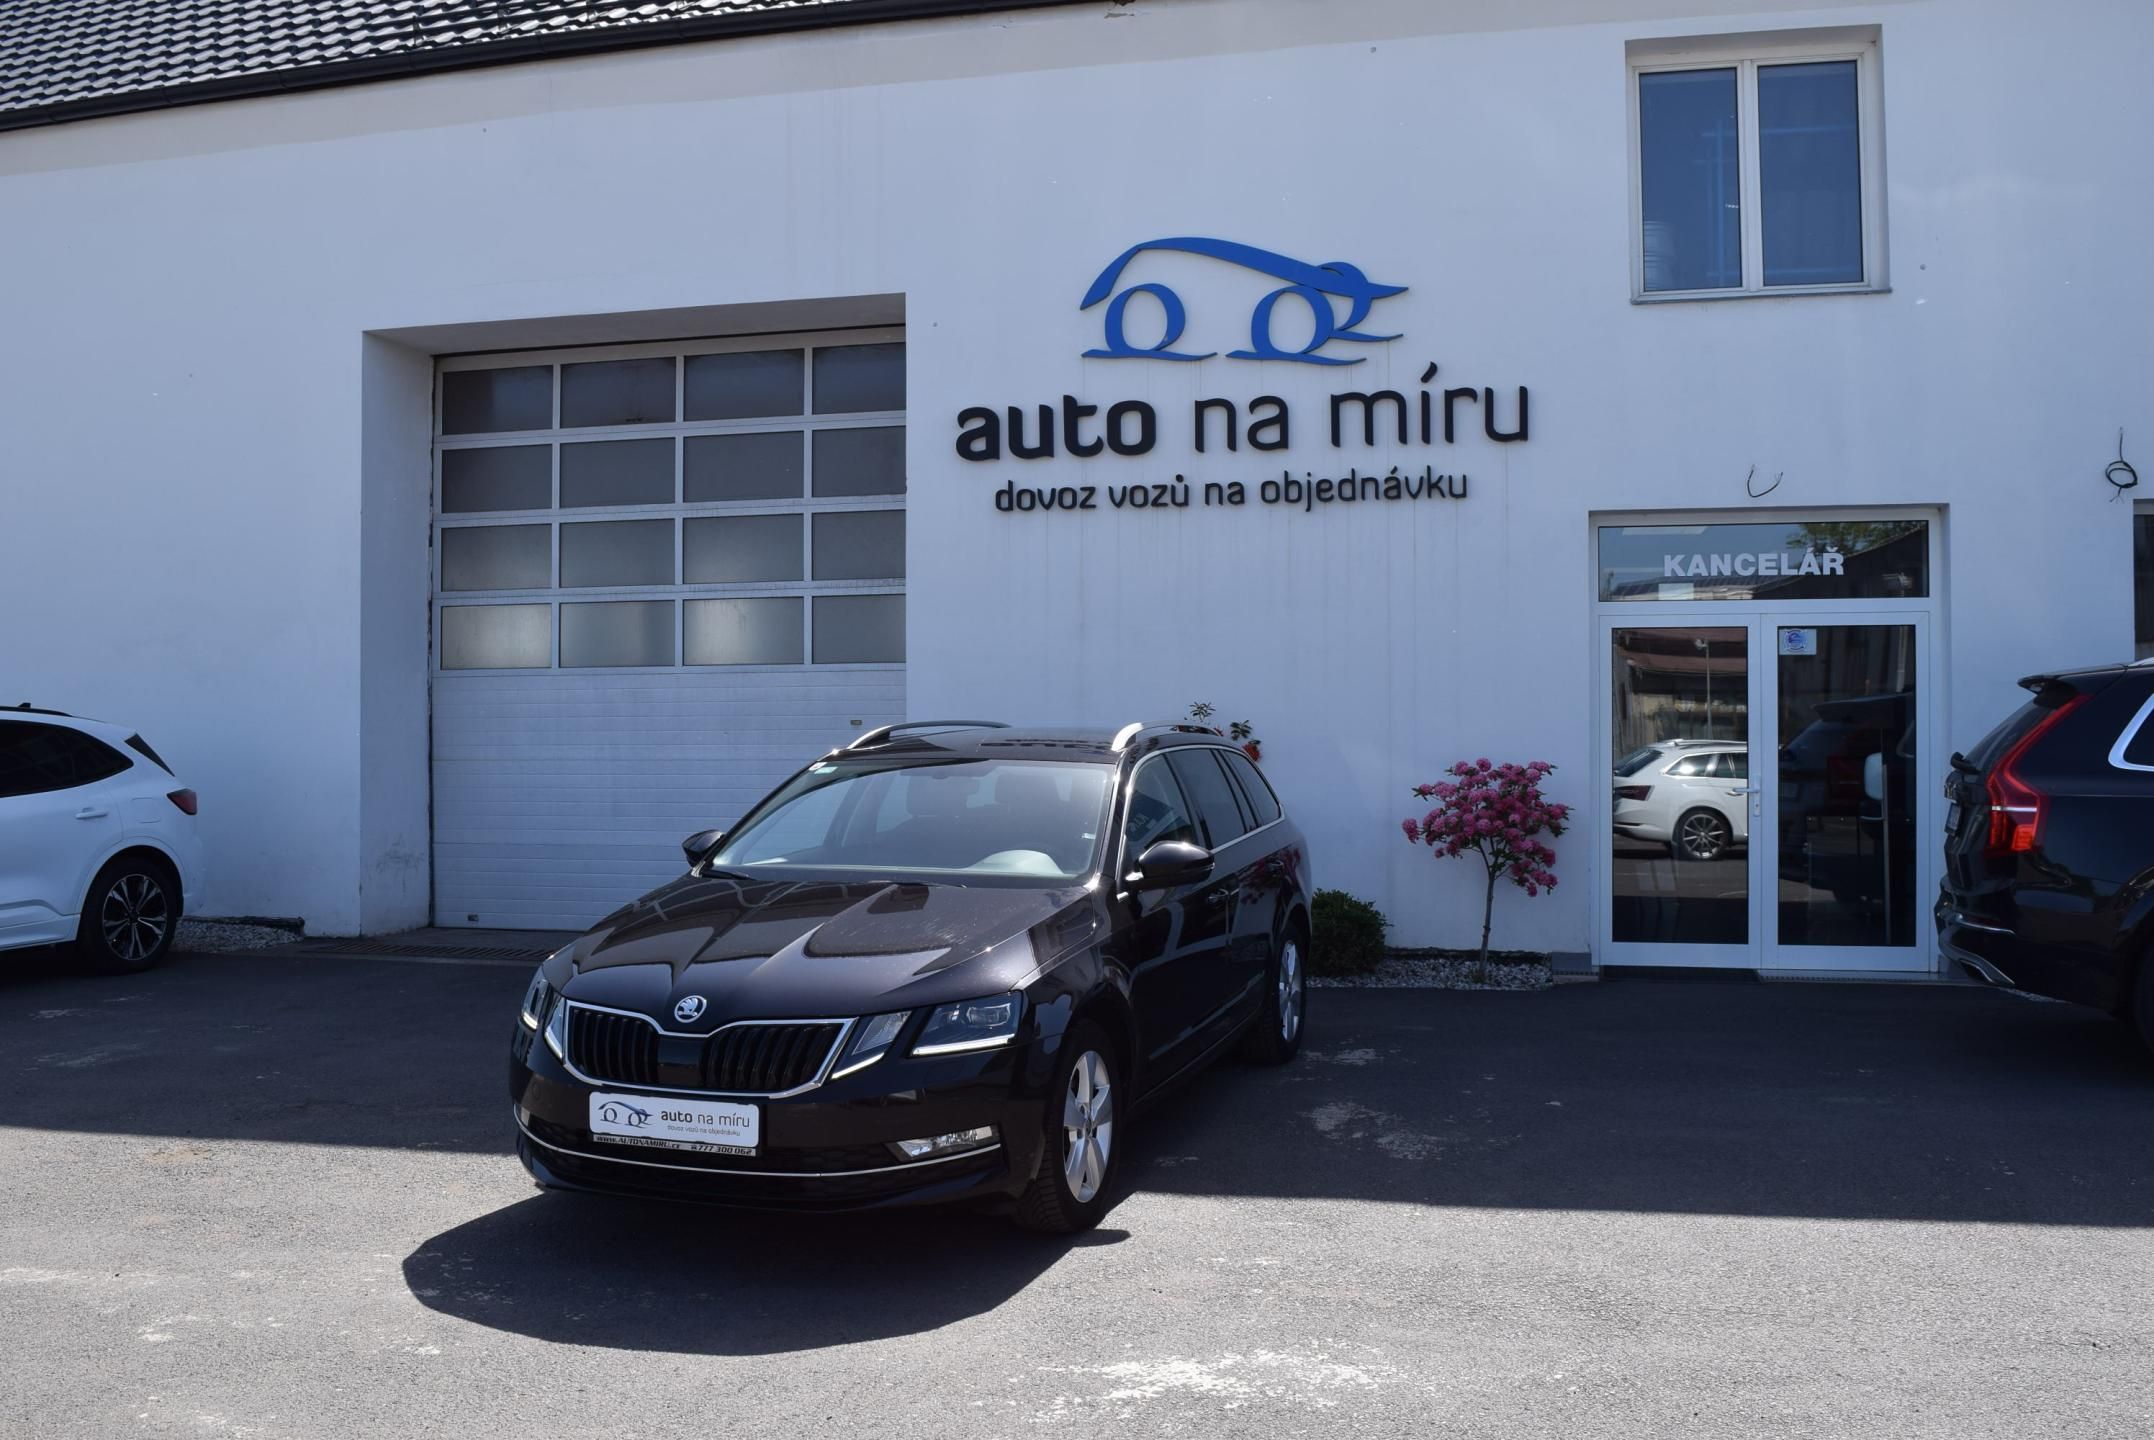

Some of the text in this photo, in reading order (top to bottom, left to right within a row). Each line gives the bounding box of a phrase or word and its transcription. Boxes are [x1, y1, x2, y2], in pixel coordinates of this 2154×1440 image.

[955, 361, 1529, 462] auto na míru
[994, 464, 1468, 513] dovoz vozů na objednávku
[1663, 546, 1845, 577] KANCELÁŘ
[660, 1110, 751, 1128] auto na míru
